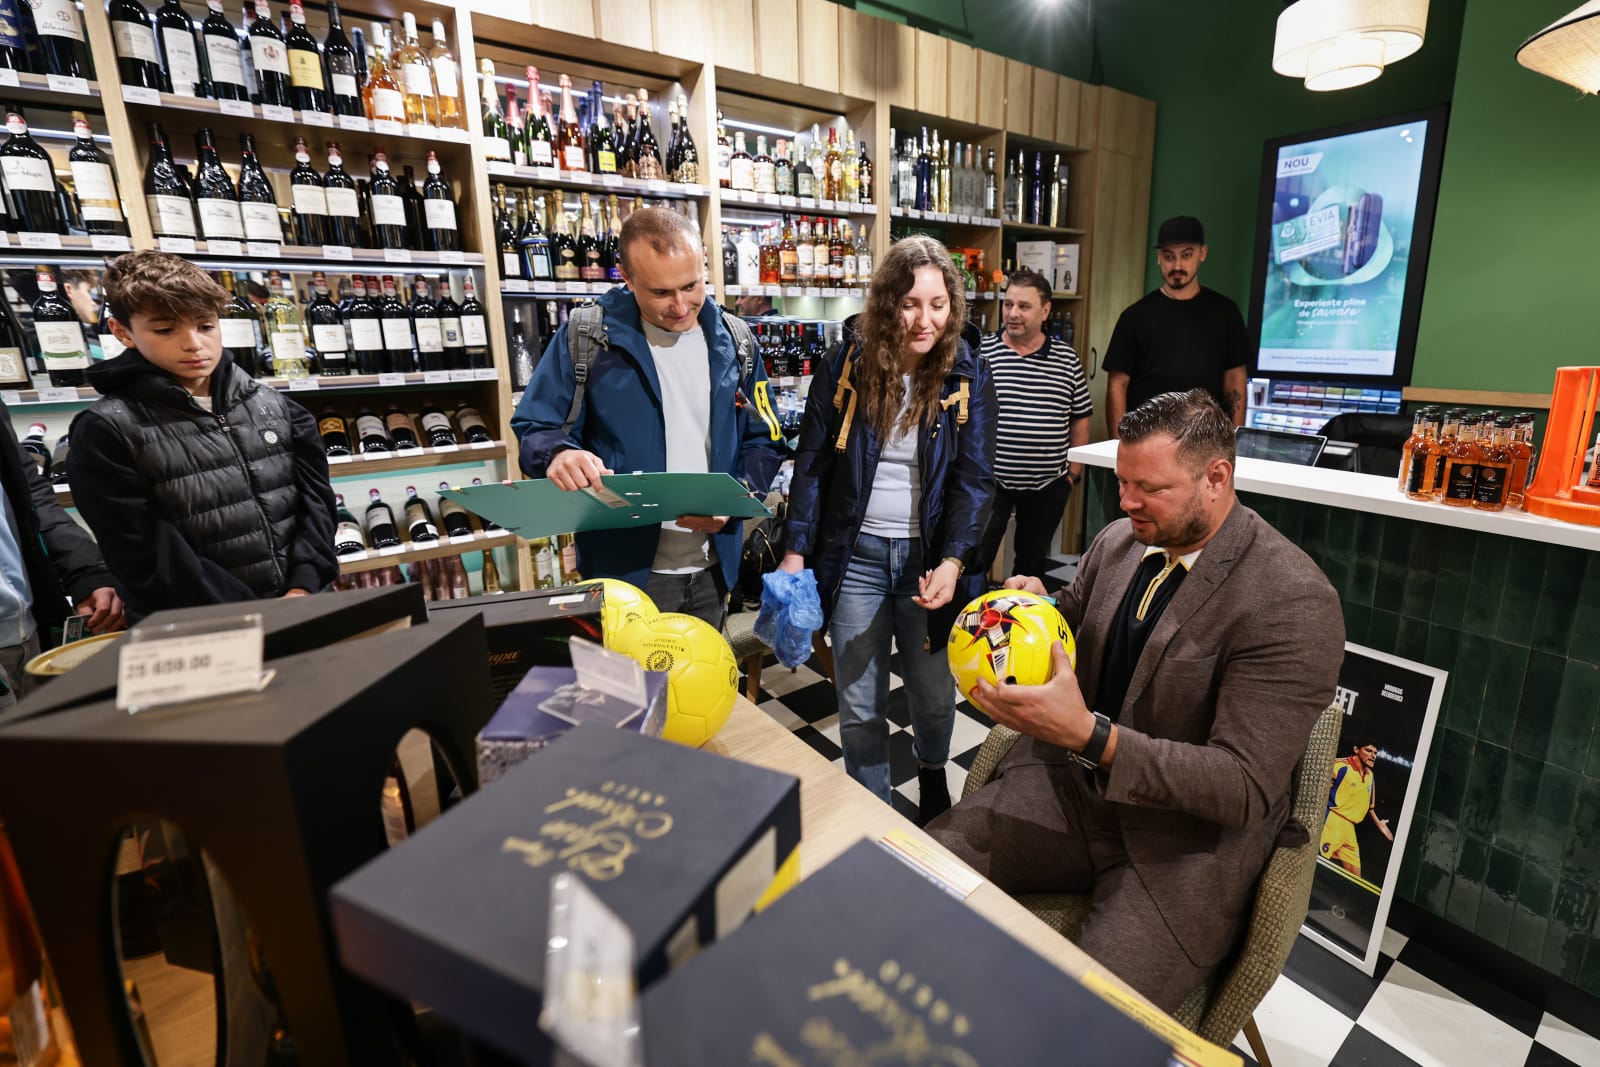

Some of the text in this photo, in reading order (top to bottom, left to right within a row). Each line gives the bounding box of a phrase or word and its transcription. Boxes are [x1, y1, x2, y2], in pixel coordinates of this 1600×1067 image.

[1283, 157, 1309, 169] NOU
[1303, 210, 1335, 229] LEVIA
[1322, 842, 1331, 853] 6
